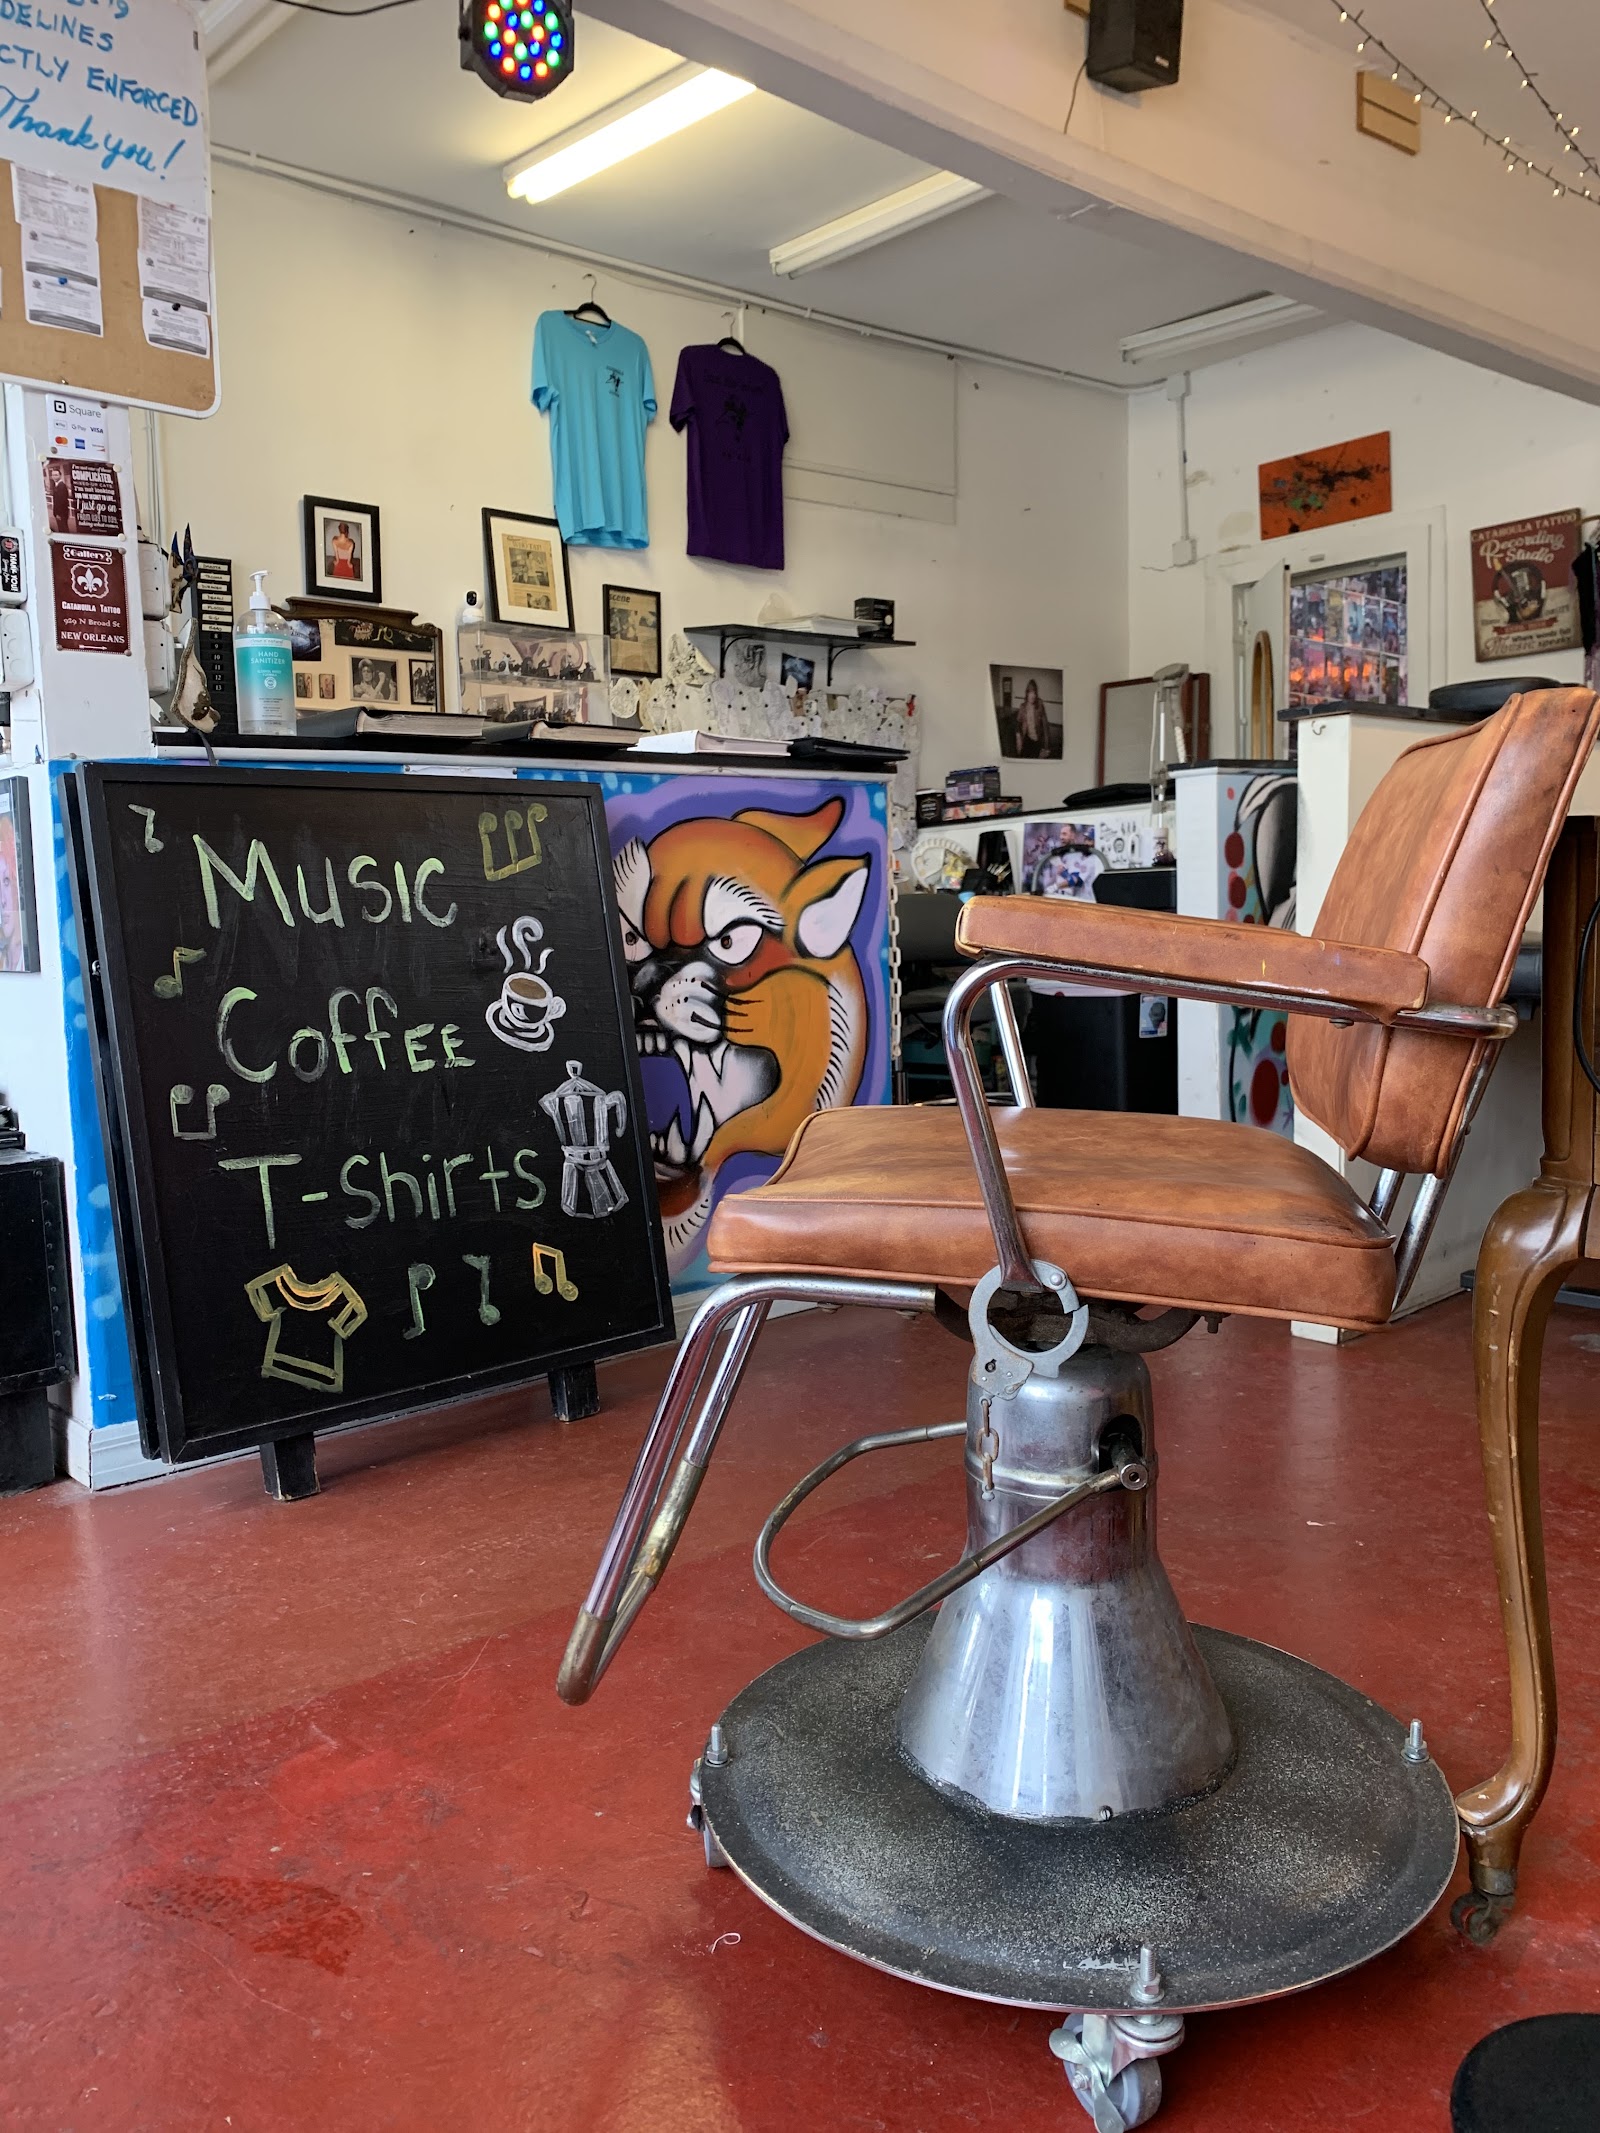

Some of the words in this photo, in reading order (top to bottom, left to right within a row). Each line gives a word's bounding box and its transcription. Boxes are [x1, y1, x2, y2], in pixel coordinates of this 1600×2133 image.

[86, 66, 198, 126] ENFORCED
[0, 85, 99, 150] Thank
[101, 133, 186, 180] you!
[69, 404, 102, 418] Square
[80, 500, 95, 513] just
[96, 503, 106, 515] go
[107, 504, 117, 512] on
[1535, 513, 1577, 529] TATTOO
[70, 549, 105, 560] Gallery
[1479, 530, 1566, 569] Recording
[1505, 547, 1555, 564] Studio
[100, 604, 121, 614] TATTOO
[88, 618, 110, 627] Broad
[61, 631, 81, 640] NEW
[83, 632, 125, 643] ORLEANS
